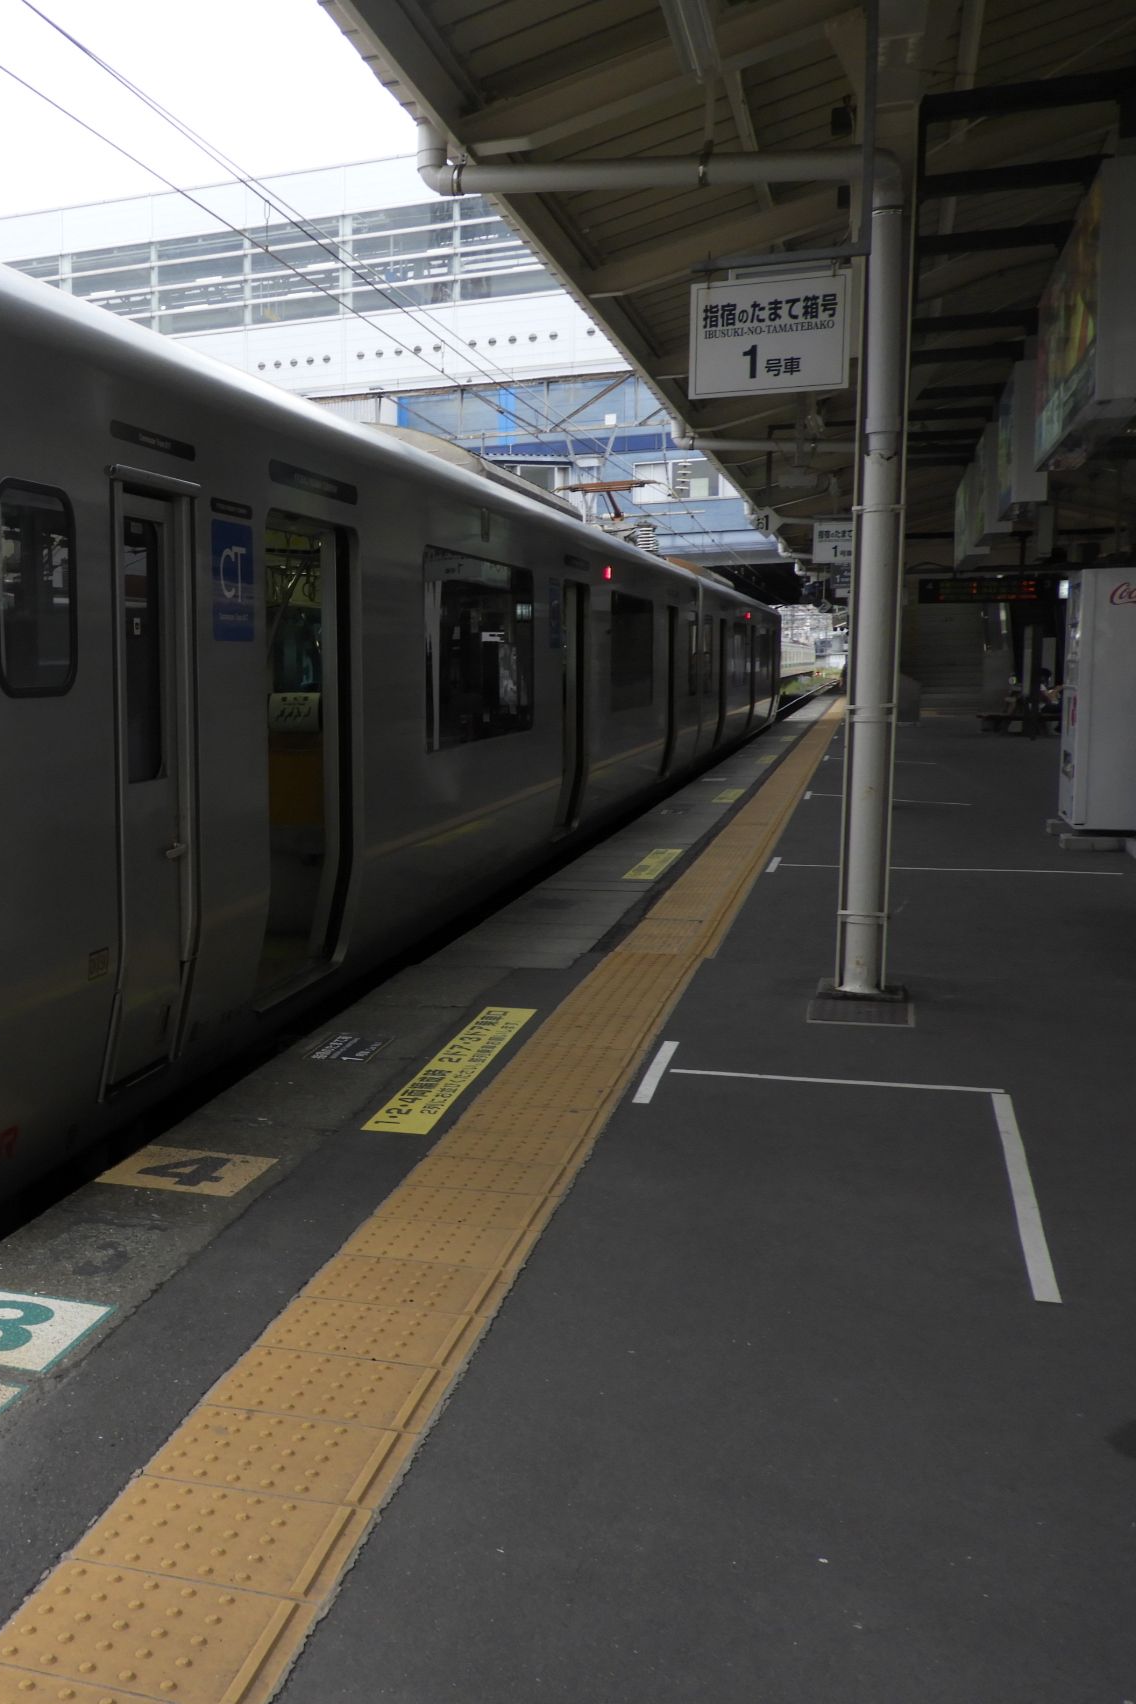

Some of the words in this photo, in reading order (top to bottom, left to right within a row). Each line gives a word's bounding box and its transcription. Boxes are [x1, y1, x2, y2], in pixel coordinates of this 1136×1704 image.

[702, 293, 839, 329] 指宿のたまて箱号
[704, 319, 835, 340] IBUSUKI-NO-TAMATEBAKO
[220, 546, 246, 602] CT
[136, 1156, 233, 1187] 4
